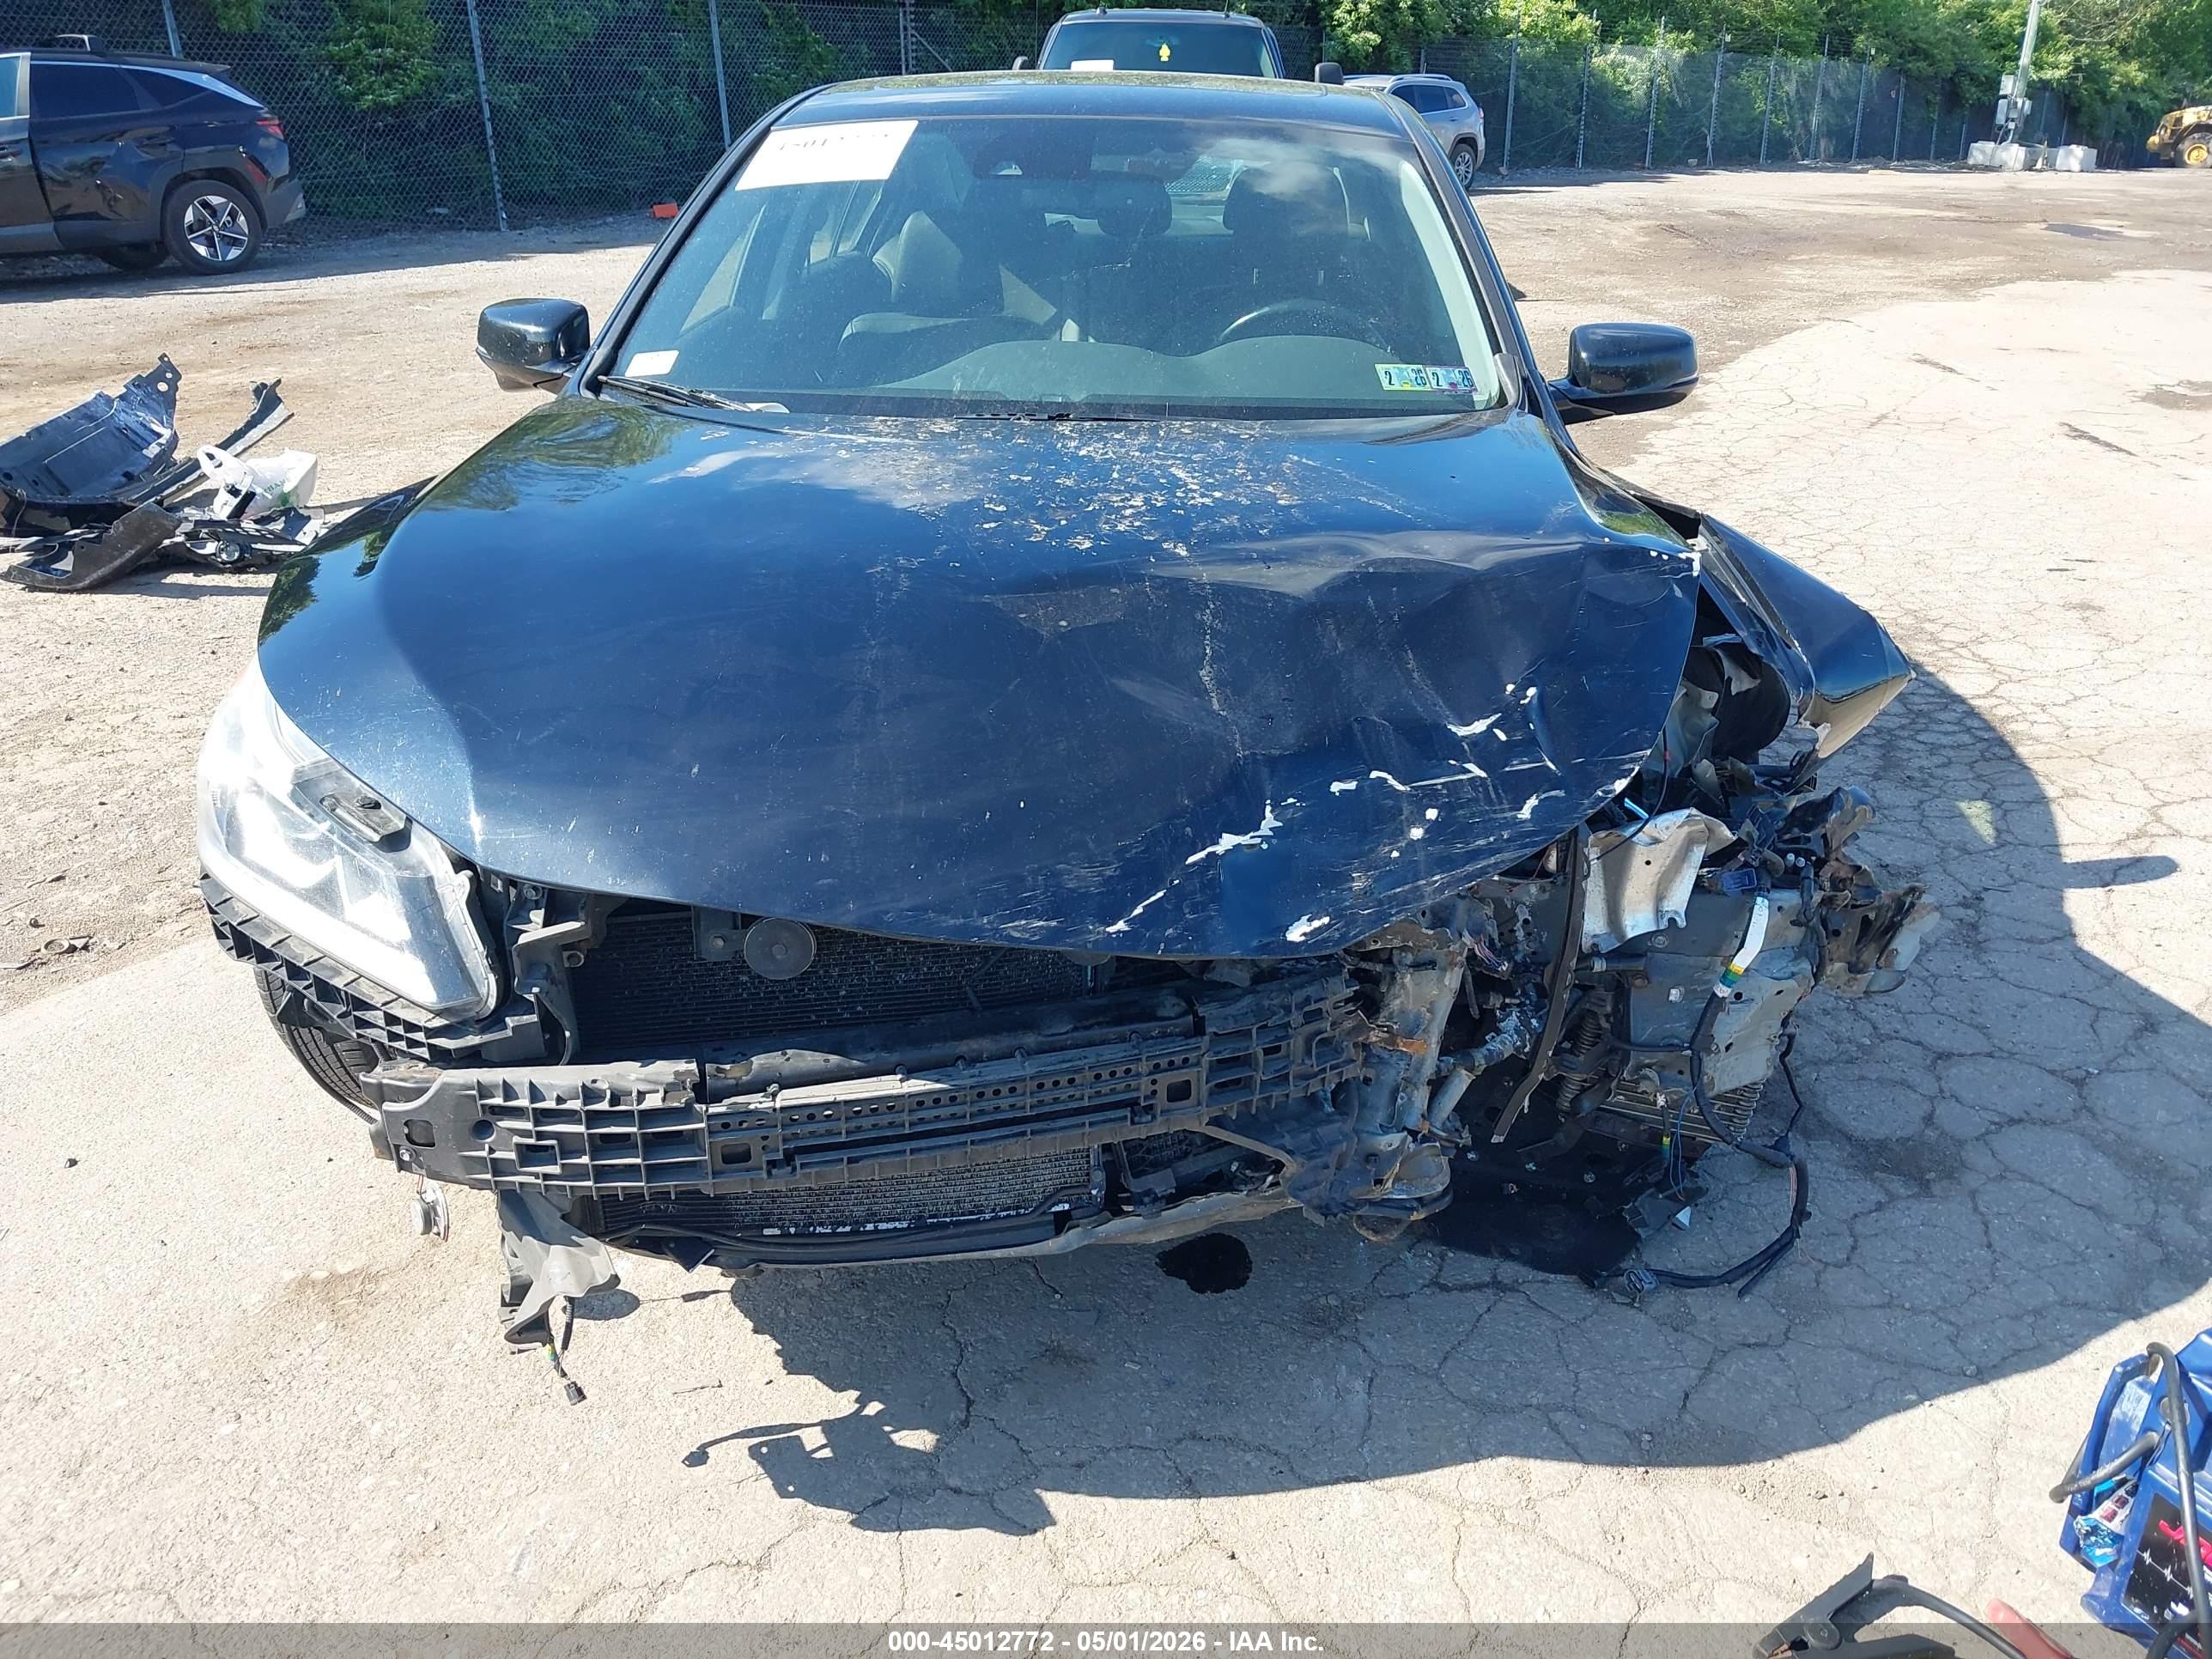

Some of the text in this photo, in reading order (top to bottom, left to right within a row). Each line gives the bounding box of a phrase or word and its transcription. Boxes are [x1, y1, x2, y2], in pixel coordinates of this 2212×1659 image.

[1384, 370, 1395, 386] 2
[1431, 369, 1474, 387] 2 26
